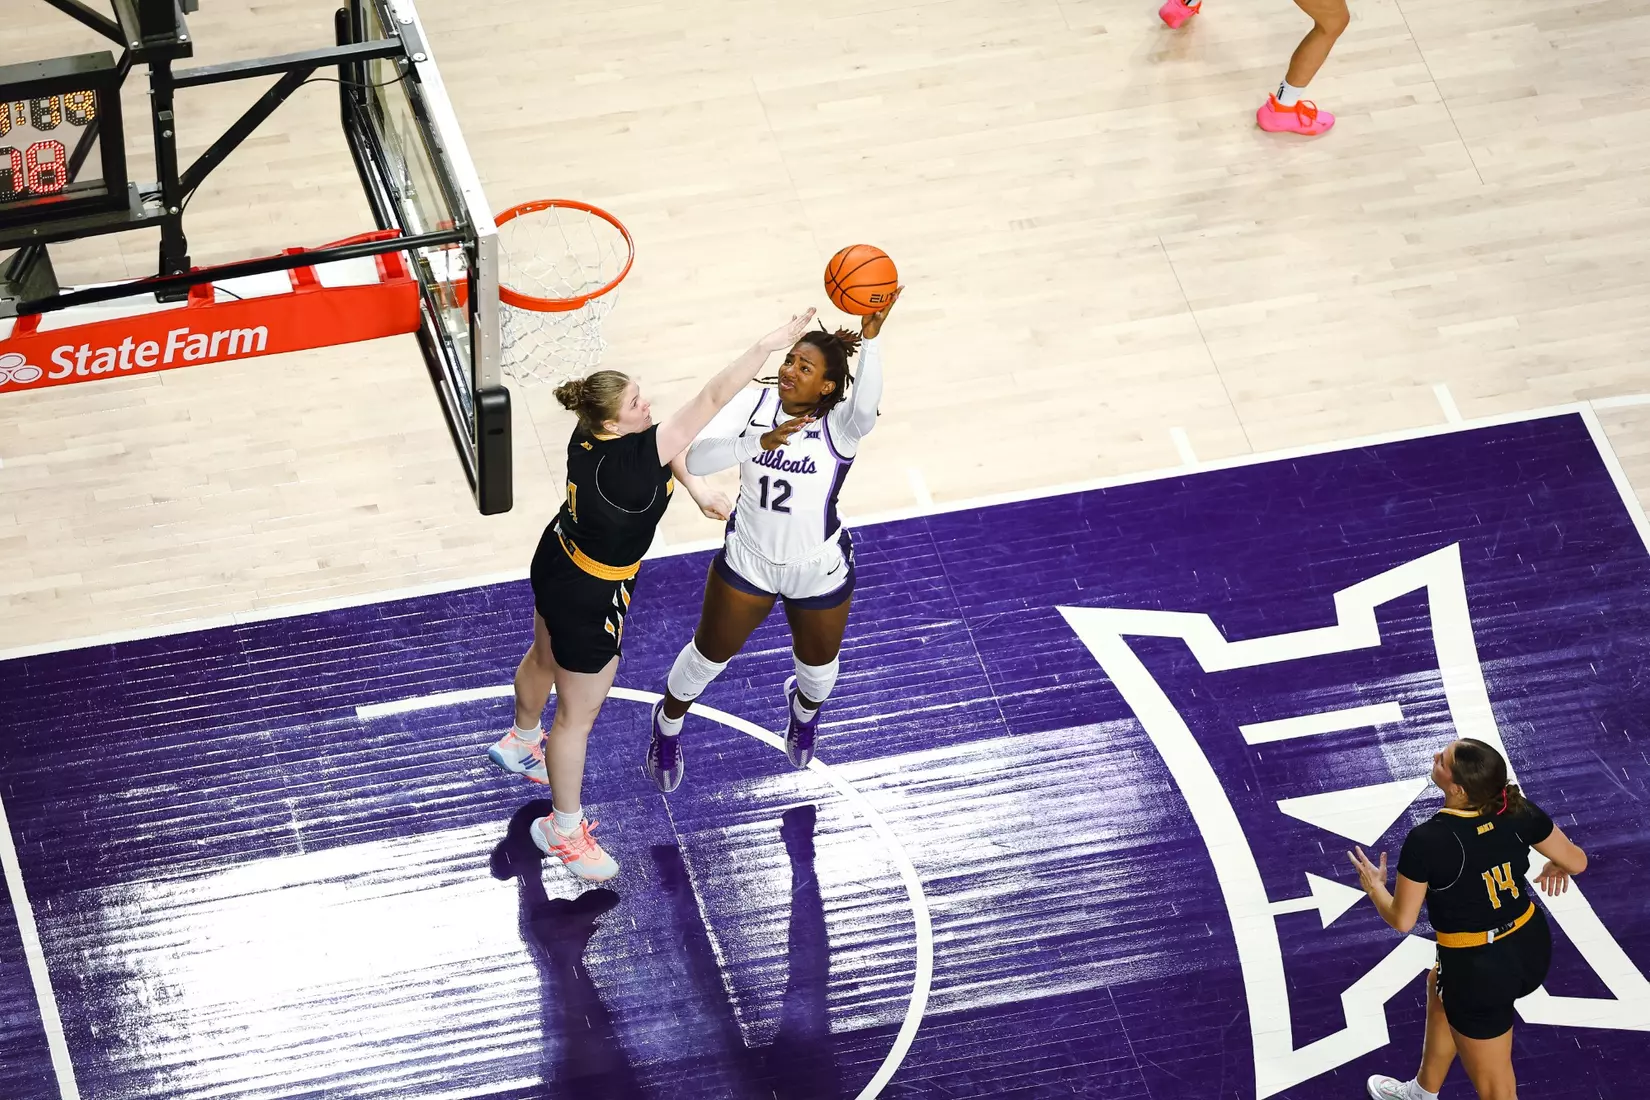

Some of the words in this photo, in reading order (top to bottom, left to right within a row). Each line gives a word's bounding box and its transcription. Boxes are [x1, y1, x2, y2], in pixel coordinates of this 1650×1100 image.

[752, 449, 817, 474] ildcats
[759, 475, 793, 515] 12
[1481, 862, 1519, 909] 14
